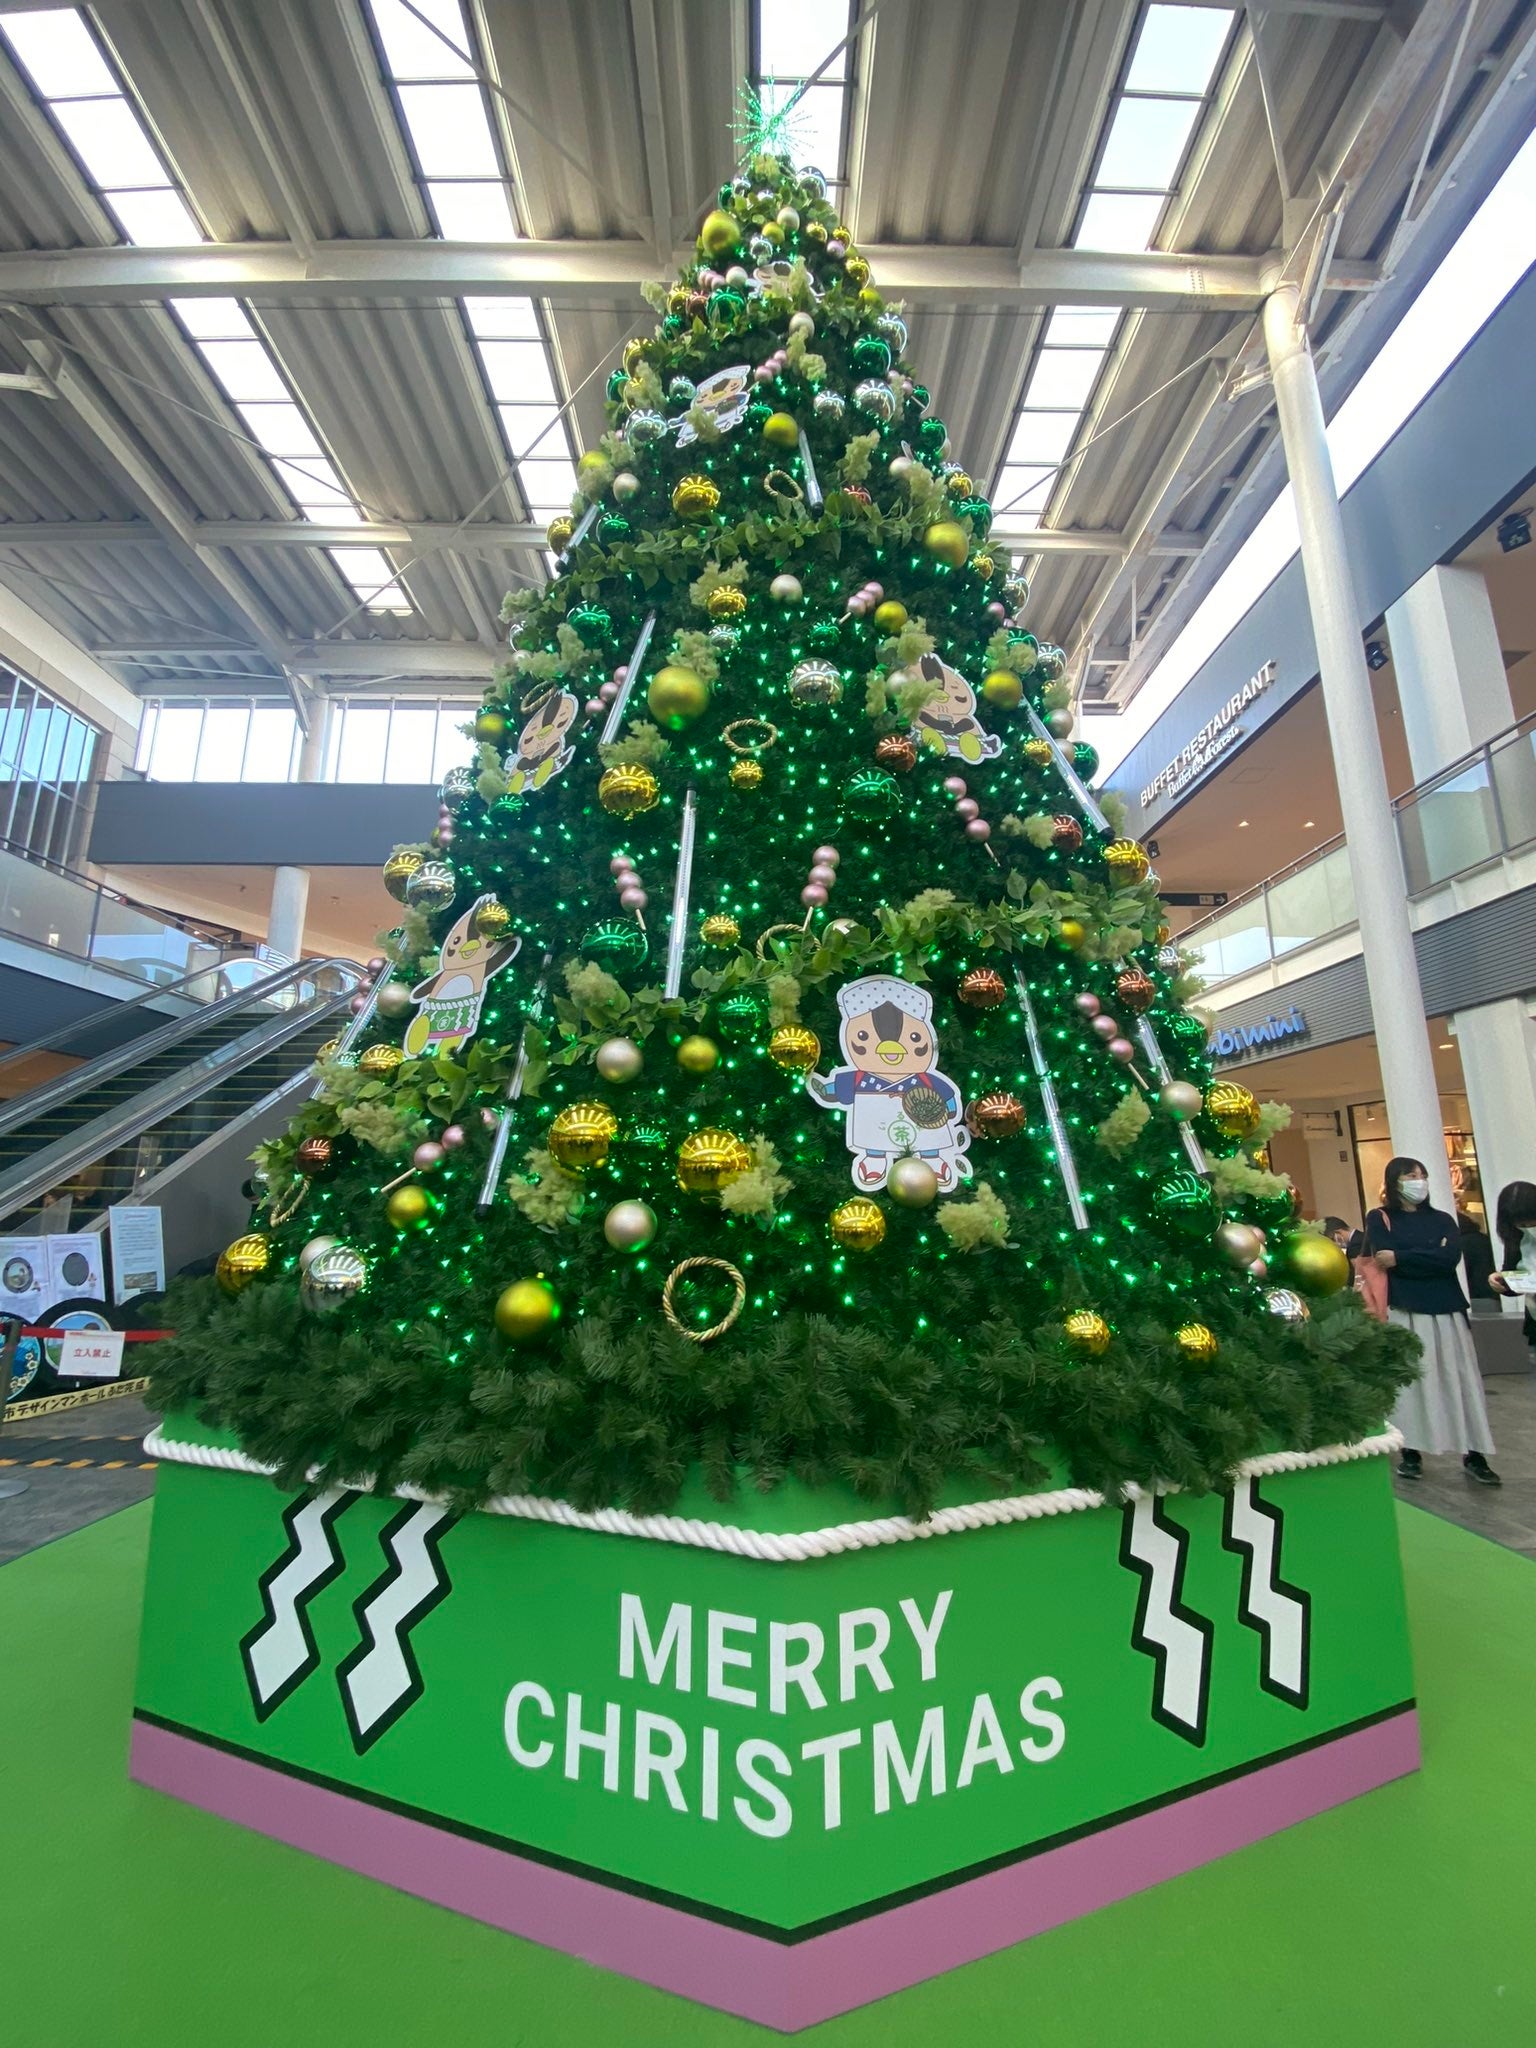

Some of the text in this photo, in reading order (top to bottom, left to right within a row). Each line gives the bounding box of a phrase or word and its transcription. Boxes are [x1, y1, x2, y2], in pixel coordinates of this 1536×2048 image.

[1140, 659, 1274, 808] BUFFET RESTAURANT
[73, 1347, 112, 1358] 立入禁止
[618, 1590, 953, 1715] MERRY
[503, 1676, 1066, 1839] CHRISTMAS
